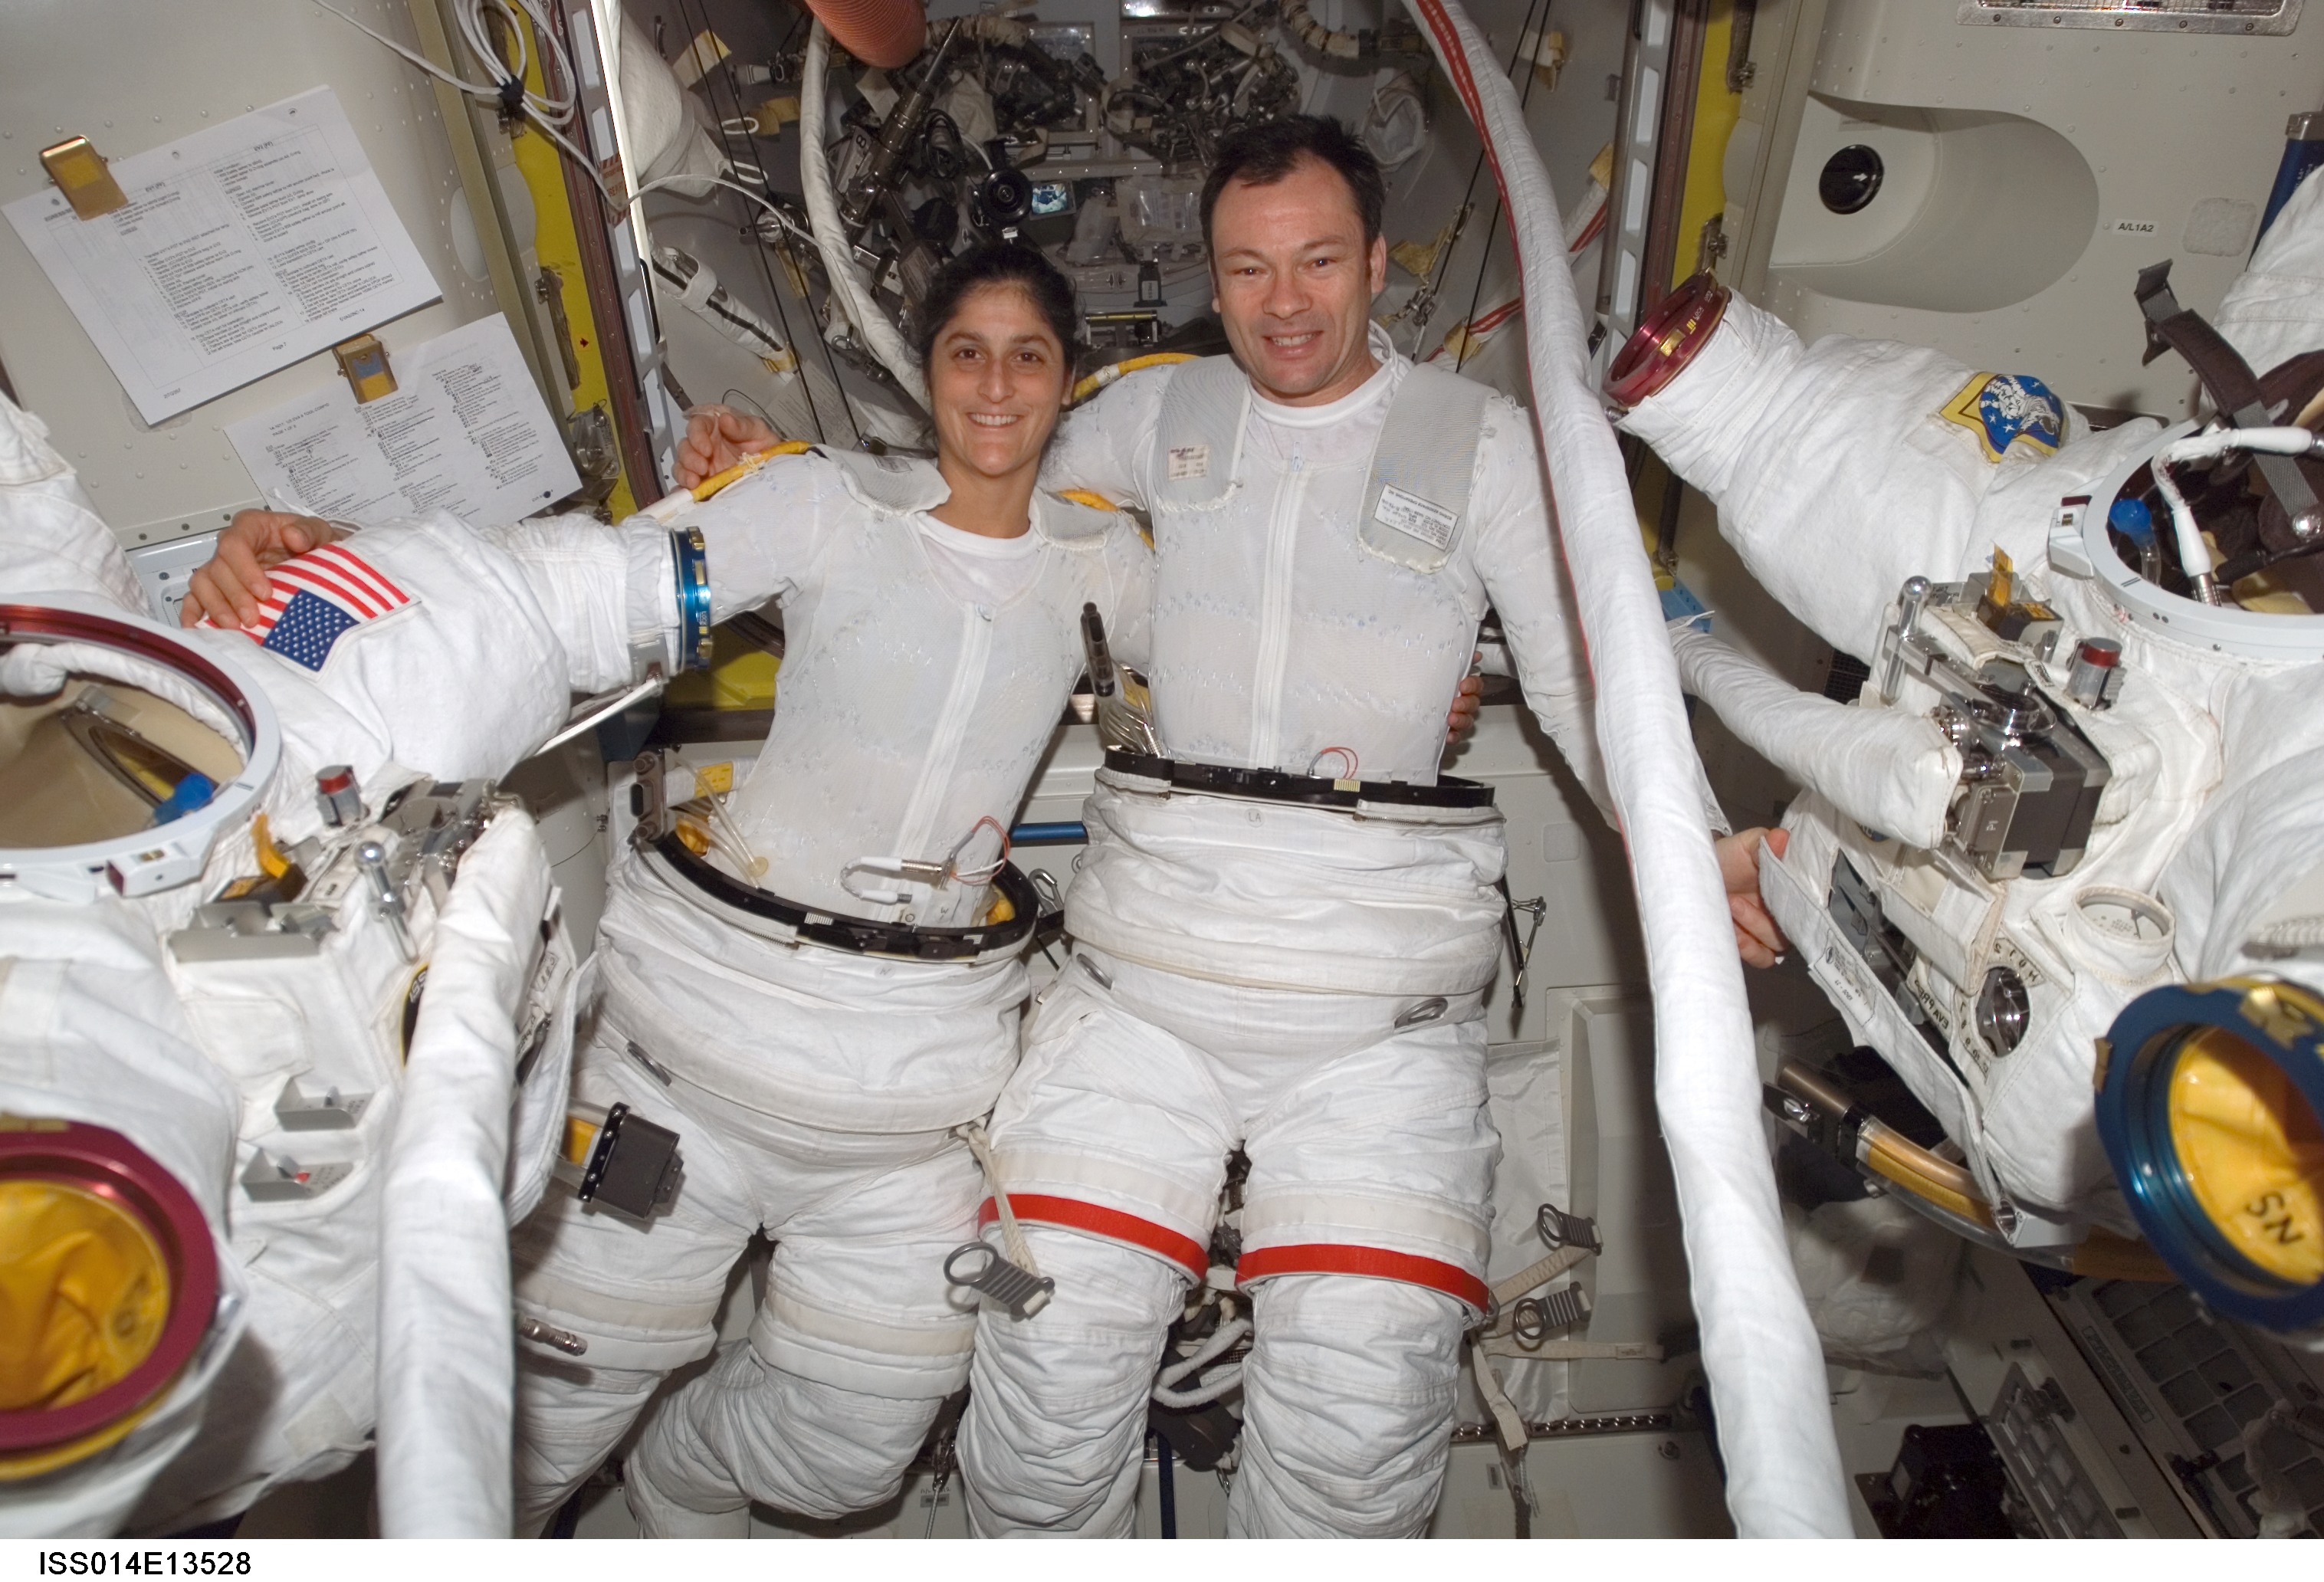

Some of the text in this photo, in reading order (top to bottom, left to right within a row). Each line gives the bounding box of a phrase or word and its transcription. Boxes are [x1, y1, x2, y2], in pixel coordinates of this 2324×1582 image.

[856, 135, 867, 148] 8
[2118, 222, 2154, 232] A/L1A2
[1693, 306, 1704, 320] LOCK
[1395, 493, 1417, 505] OPERATIONS
[1418, 502, 1439, 515] AEROSPACE
[1439, 511, 1452, 520] BOEING
[1248, 812, 1262, 822] LA
[2244, 1190, 2306, 1245] SN
